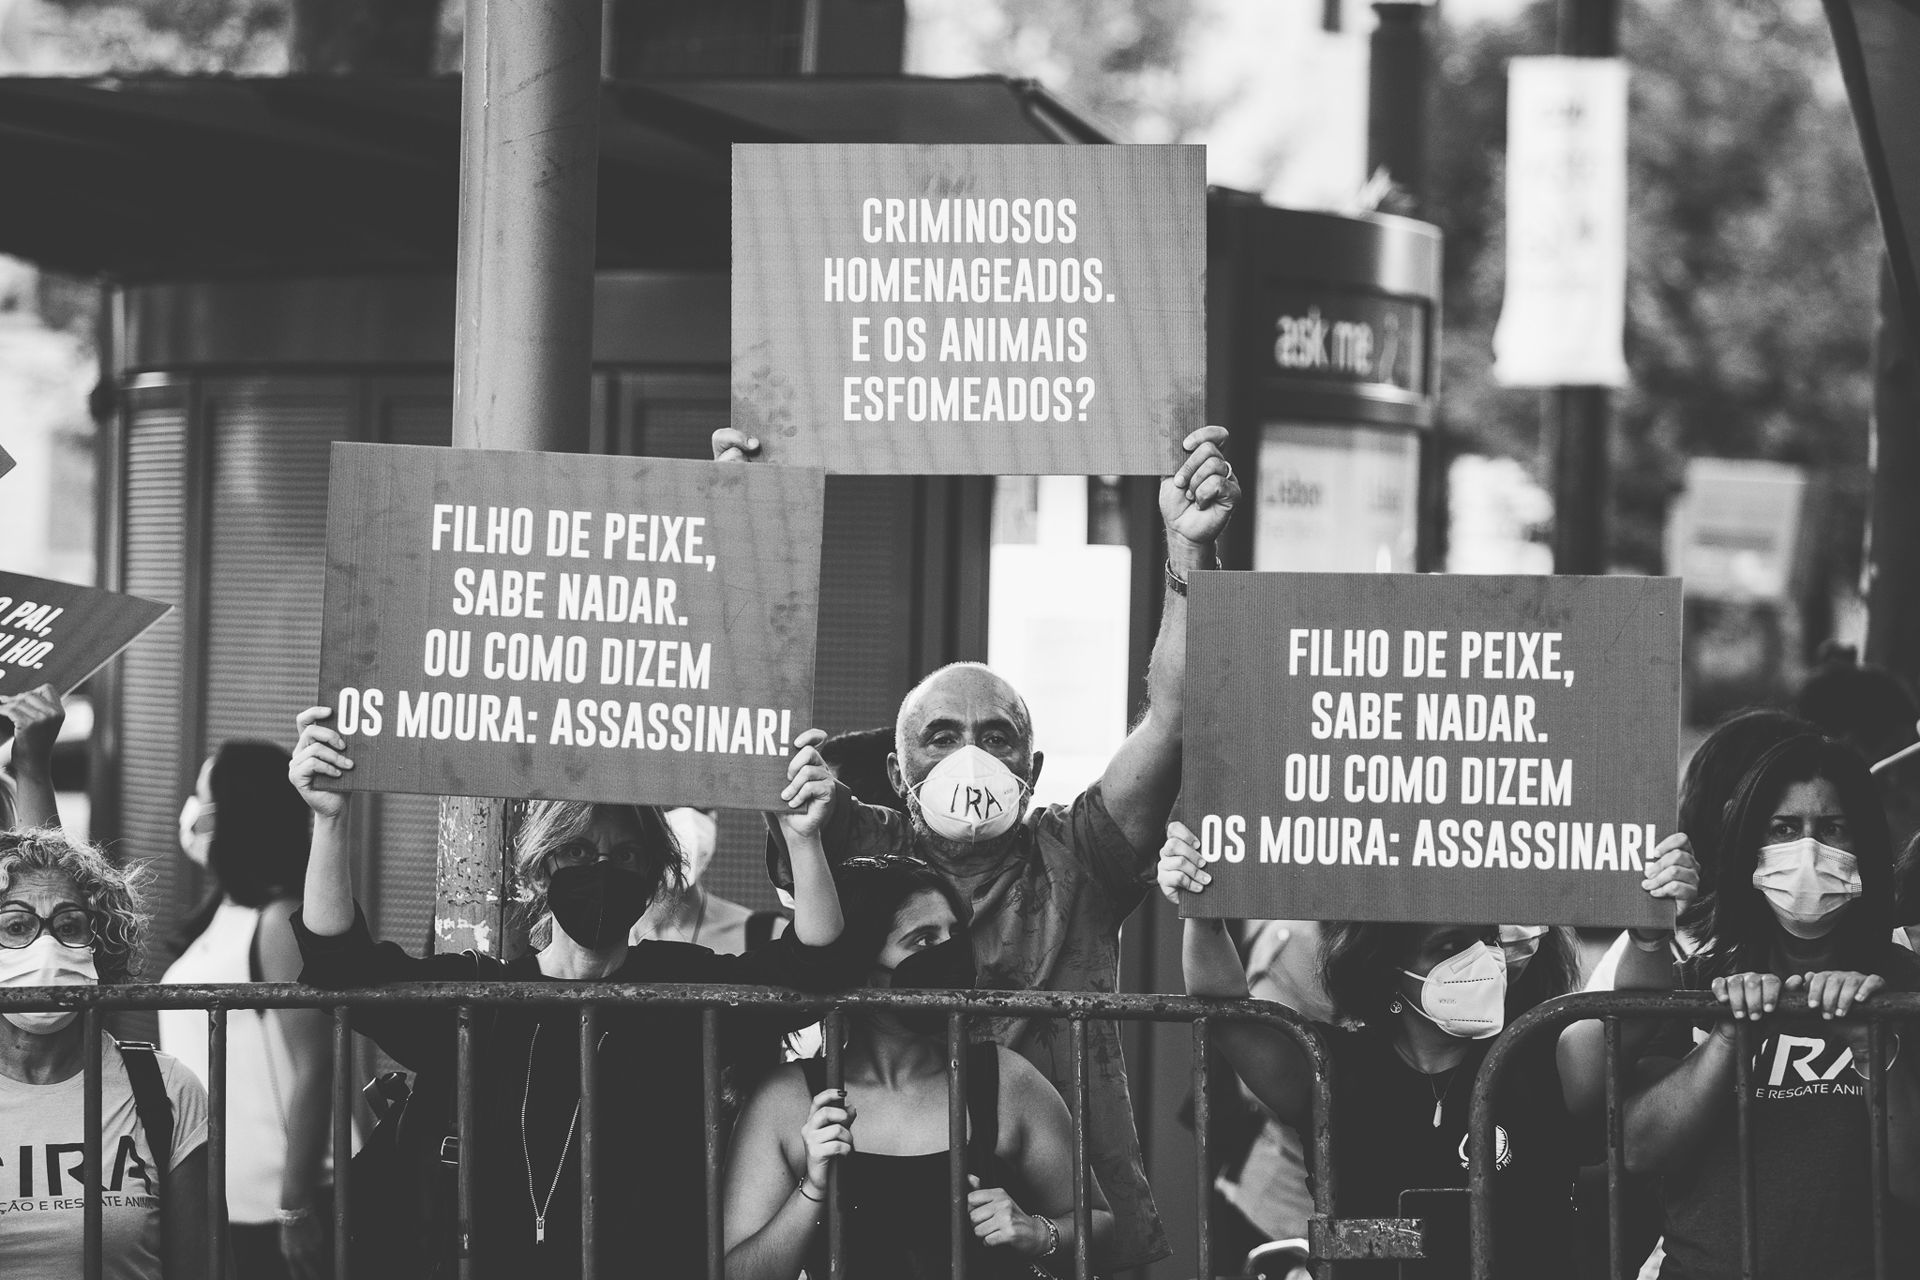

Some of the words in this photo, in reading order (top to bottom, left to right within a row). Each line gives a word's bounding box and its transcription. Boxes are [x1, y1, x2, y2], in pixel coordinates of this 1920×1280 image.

[862, 197, 1077, 245] CRIMINOSOS
[823, 256, 1116, 304] HOMENAGEADOS.
[852, 316, 871, 362] E
[883, 316, 927, 363] OS
[938, 316, 1088, 363] ANIMAIS
[1275, 306, 1329, 368] ask
[1331, 320, 1374, 375] me
[843, 375, 1096, 423] ESFOMEADOS?
[431, 503, 534, 556] FILHO
[546, 509, 592, 559] DE
[603, 512, 716, 573] PEIXE,
[1, 600, 64, 638] PAI,
[452, 567, 547, 619] SABE
[557, 572, 688, 626] NADAR.
[424, 628, 472, 678] OU
[483, 631, 588, 684] COMO
[600, 637, 712, 690] DIZEM
[1289, 628, 1389, 678] FILHO
[1403, 630, 1448, 678] DE
[1460, 631, 1575, 688] PEIXE,
[337, 687, 384, 737] OS
[396, 690, 538, 744] MOURA:
[549, 698, 791, 757] ASSASSINAR!
[1311, 691, 1404, 740] SABE
[1416, 693, 1548, 743] NADAR.
[950, 783, 1003, 820] IRA
[1285, 753, 1331, 802] OU
[1344, 754, 1447, 805] COMO
[1461, 757, 1573, 807] DIZEM
[1201, 814, 1246, 864] OS
[1259, 816, 1400, 866] MOURA:
[1412, 818, 1657, 872] ASSASSINAR!
[1755, 1088, 1766, 1098] E
[1768, 1083, 1829, 1099] RESGATE
[39, 1200, 49, 1211] E
